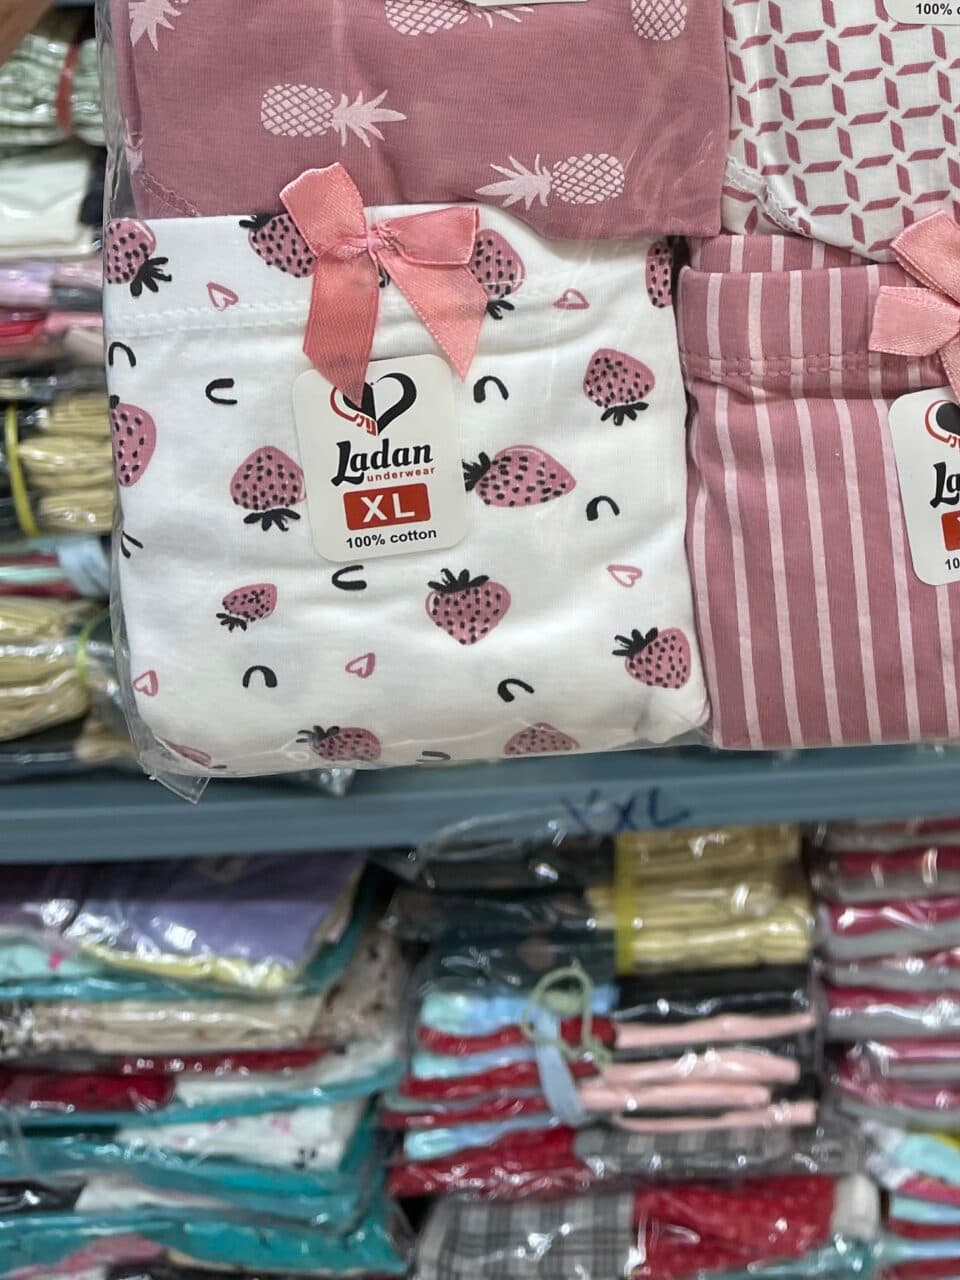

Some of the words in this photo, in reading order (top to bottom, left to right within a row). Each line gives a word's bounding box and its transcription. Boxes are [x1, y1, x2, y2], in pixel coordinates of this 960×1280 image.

[916, 3, 952, 15] 100%
[330, 438, 433, 487] Ladan
[367, 467, 435, 482] underwear
[360, 493, 415, 523] XL
[346, 534, 386, 549] 100%
[390, 530, 437, 544] cotton
